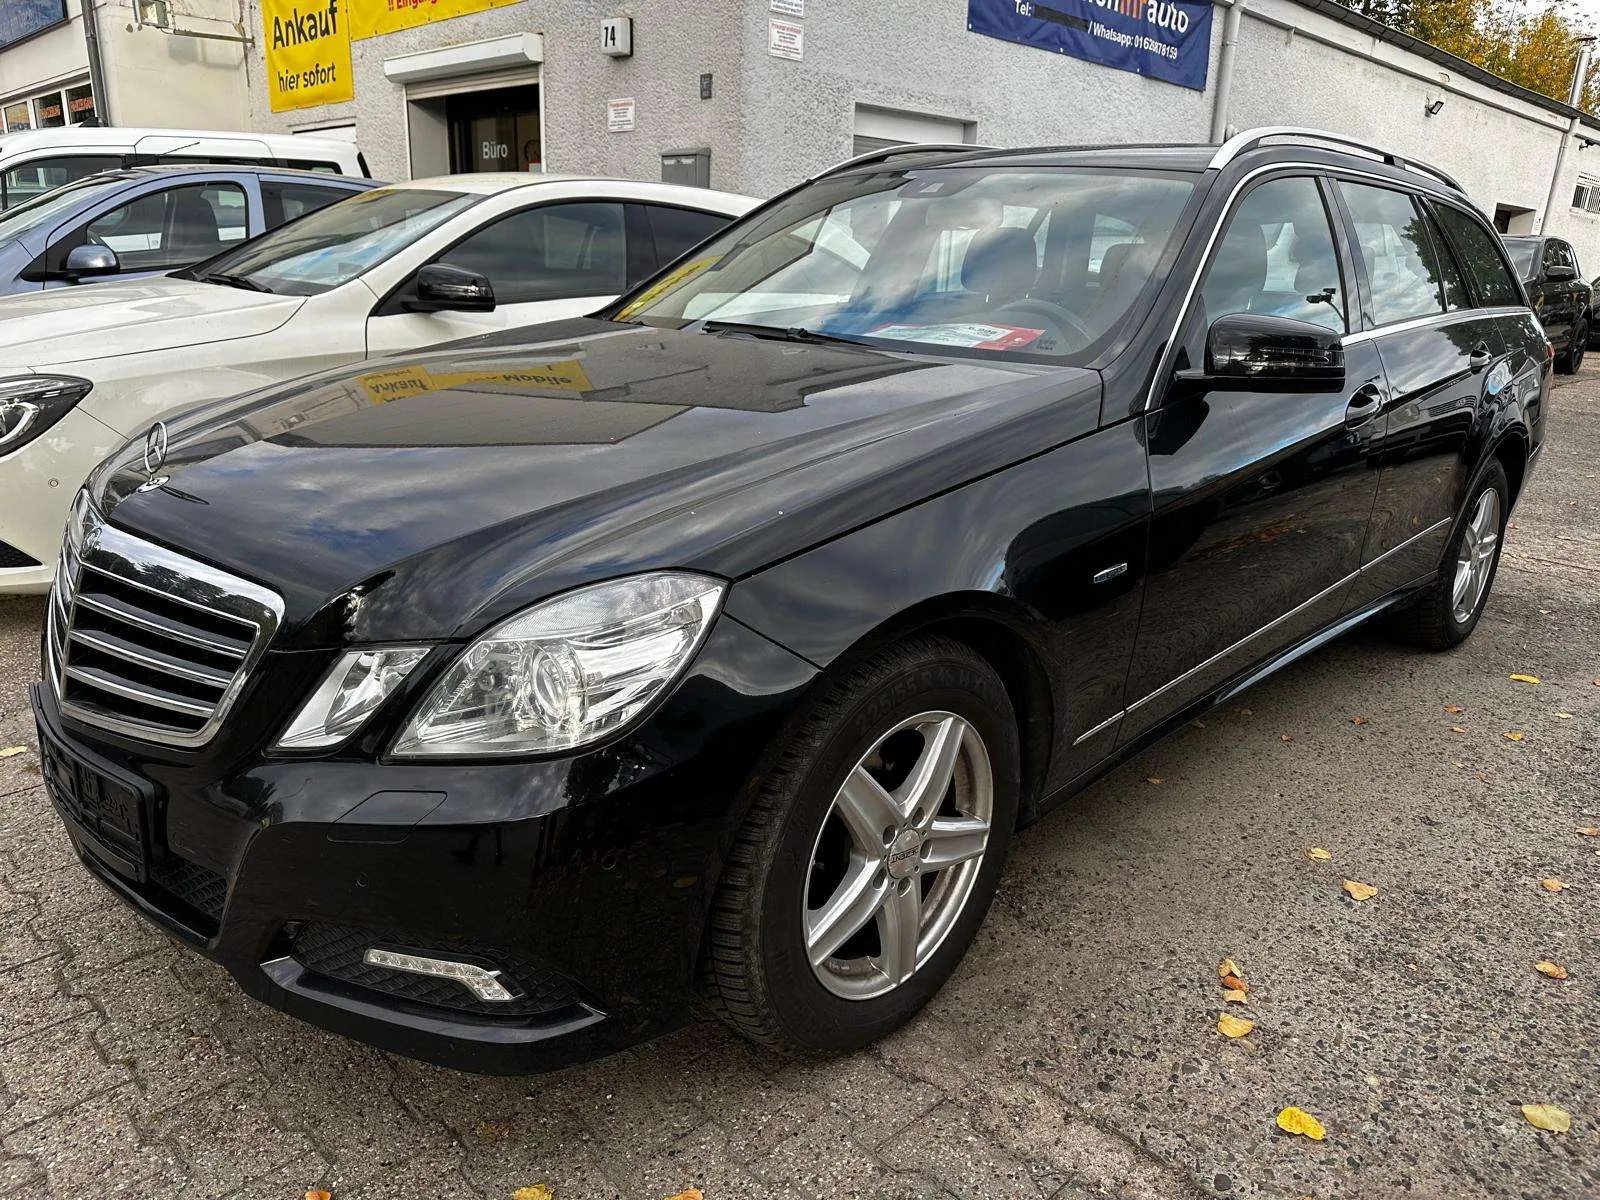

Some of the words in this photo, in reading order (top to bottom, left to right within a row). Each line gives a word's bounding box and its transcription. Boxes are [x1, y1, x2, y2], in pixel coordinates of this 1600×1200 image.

[273, 0, 337, 49] Ankauf
[603, 25, 616, 47] 74
[1015, 0, 1032, 17] Tel:
[1093, 22, 1133, 47] Whatsapp:
[277, 68, 300, 93] hier
[303, 62, 337, 88] sofort
[482, 140, 508, 159] Büro
